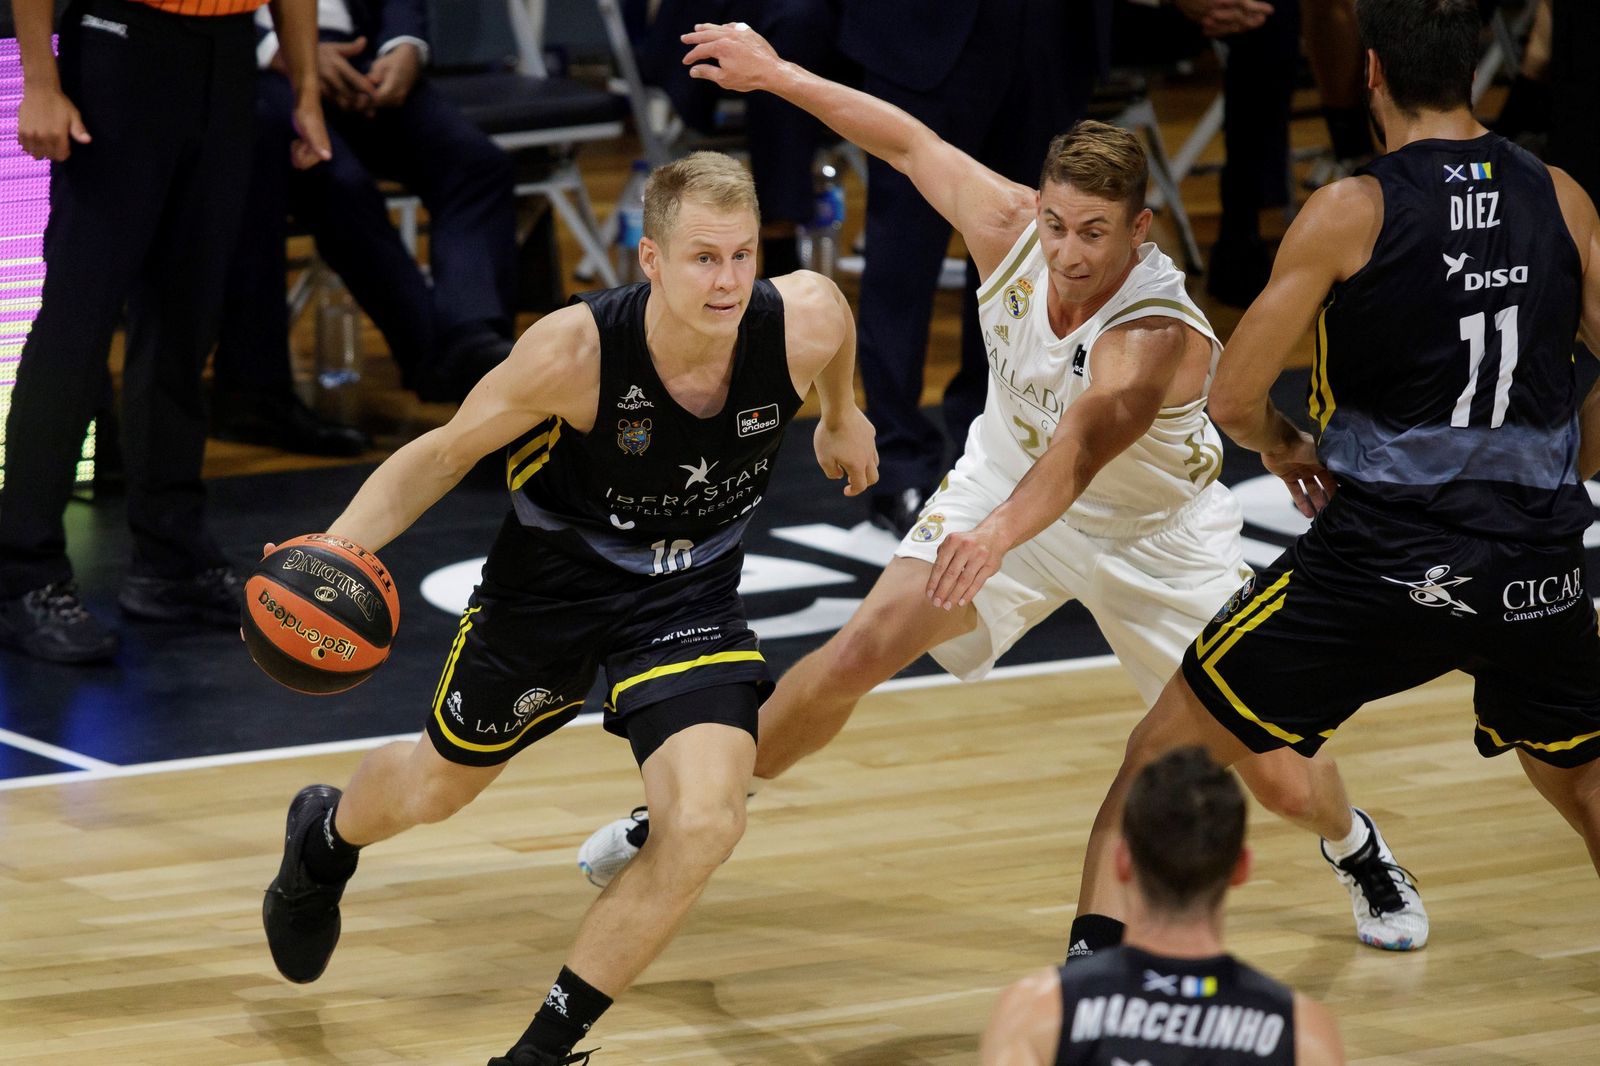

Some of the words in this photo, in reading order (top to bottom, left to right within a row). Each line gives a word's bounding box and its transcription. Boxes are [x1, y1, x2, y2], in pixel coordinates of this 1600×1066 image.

[1450, 186, 1501, 231] DÍEZ
[984, 330, 1064, 419] PALLADI
[1450, 305, 1519, 429] 11
[741, 417, 758, 430] liga
[741, 419, 777, 434] endesa
[649, 538, 695, 576] 10
[282, 548, 384, 622] SPALDING
[257, 588, 322, 644] endesa
[1503, 609, 1544, 622] Canary
[321, 634, 358, 662] liga
[476, 719, 499, 734] LA
[1070, 994, 1284, 1057] MARCELINHO
